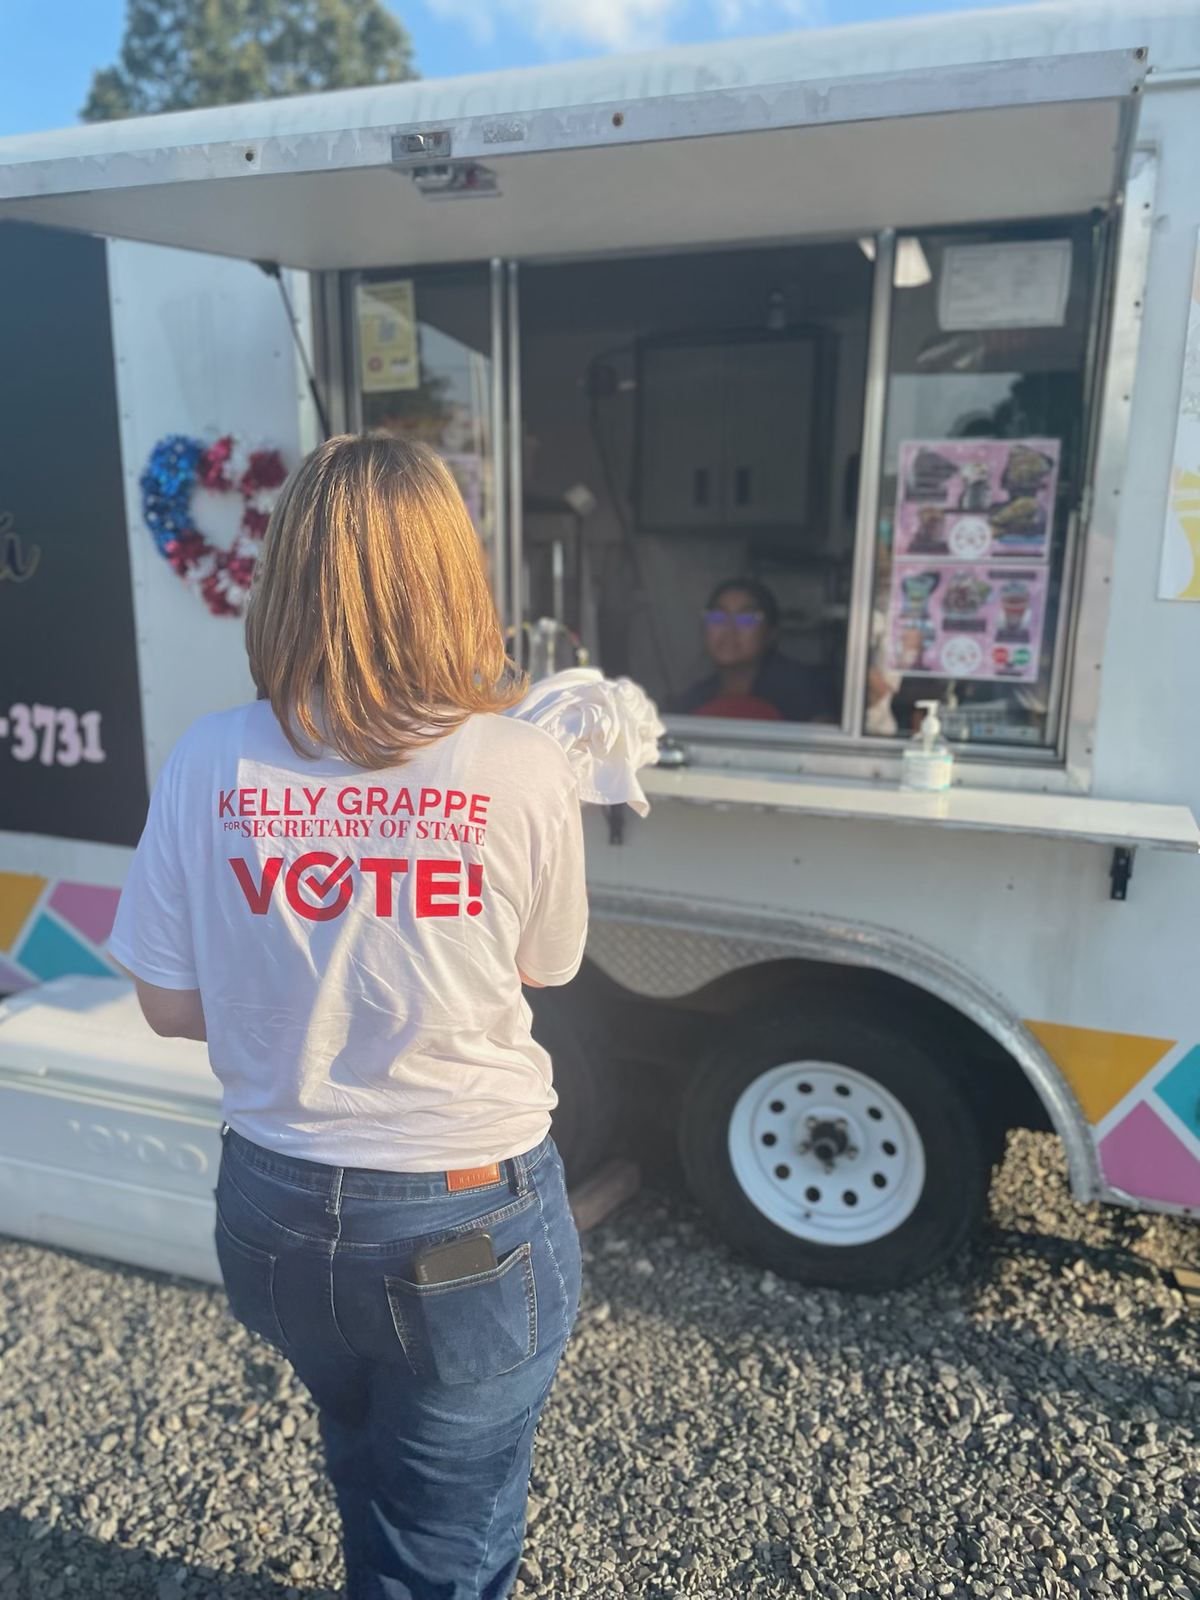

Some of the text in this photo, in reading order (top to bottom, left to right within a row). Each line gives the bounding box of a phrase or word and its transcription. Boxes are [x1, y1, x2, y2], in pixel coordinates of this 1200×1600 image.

[218, 787, 491, 825] KELLY GRAPPE
[223, 819, 486, 847] FOR SECRETARY OF STATE
[228, 851, 484, 922] VOTE!
